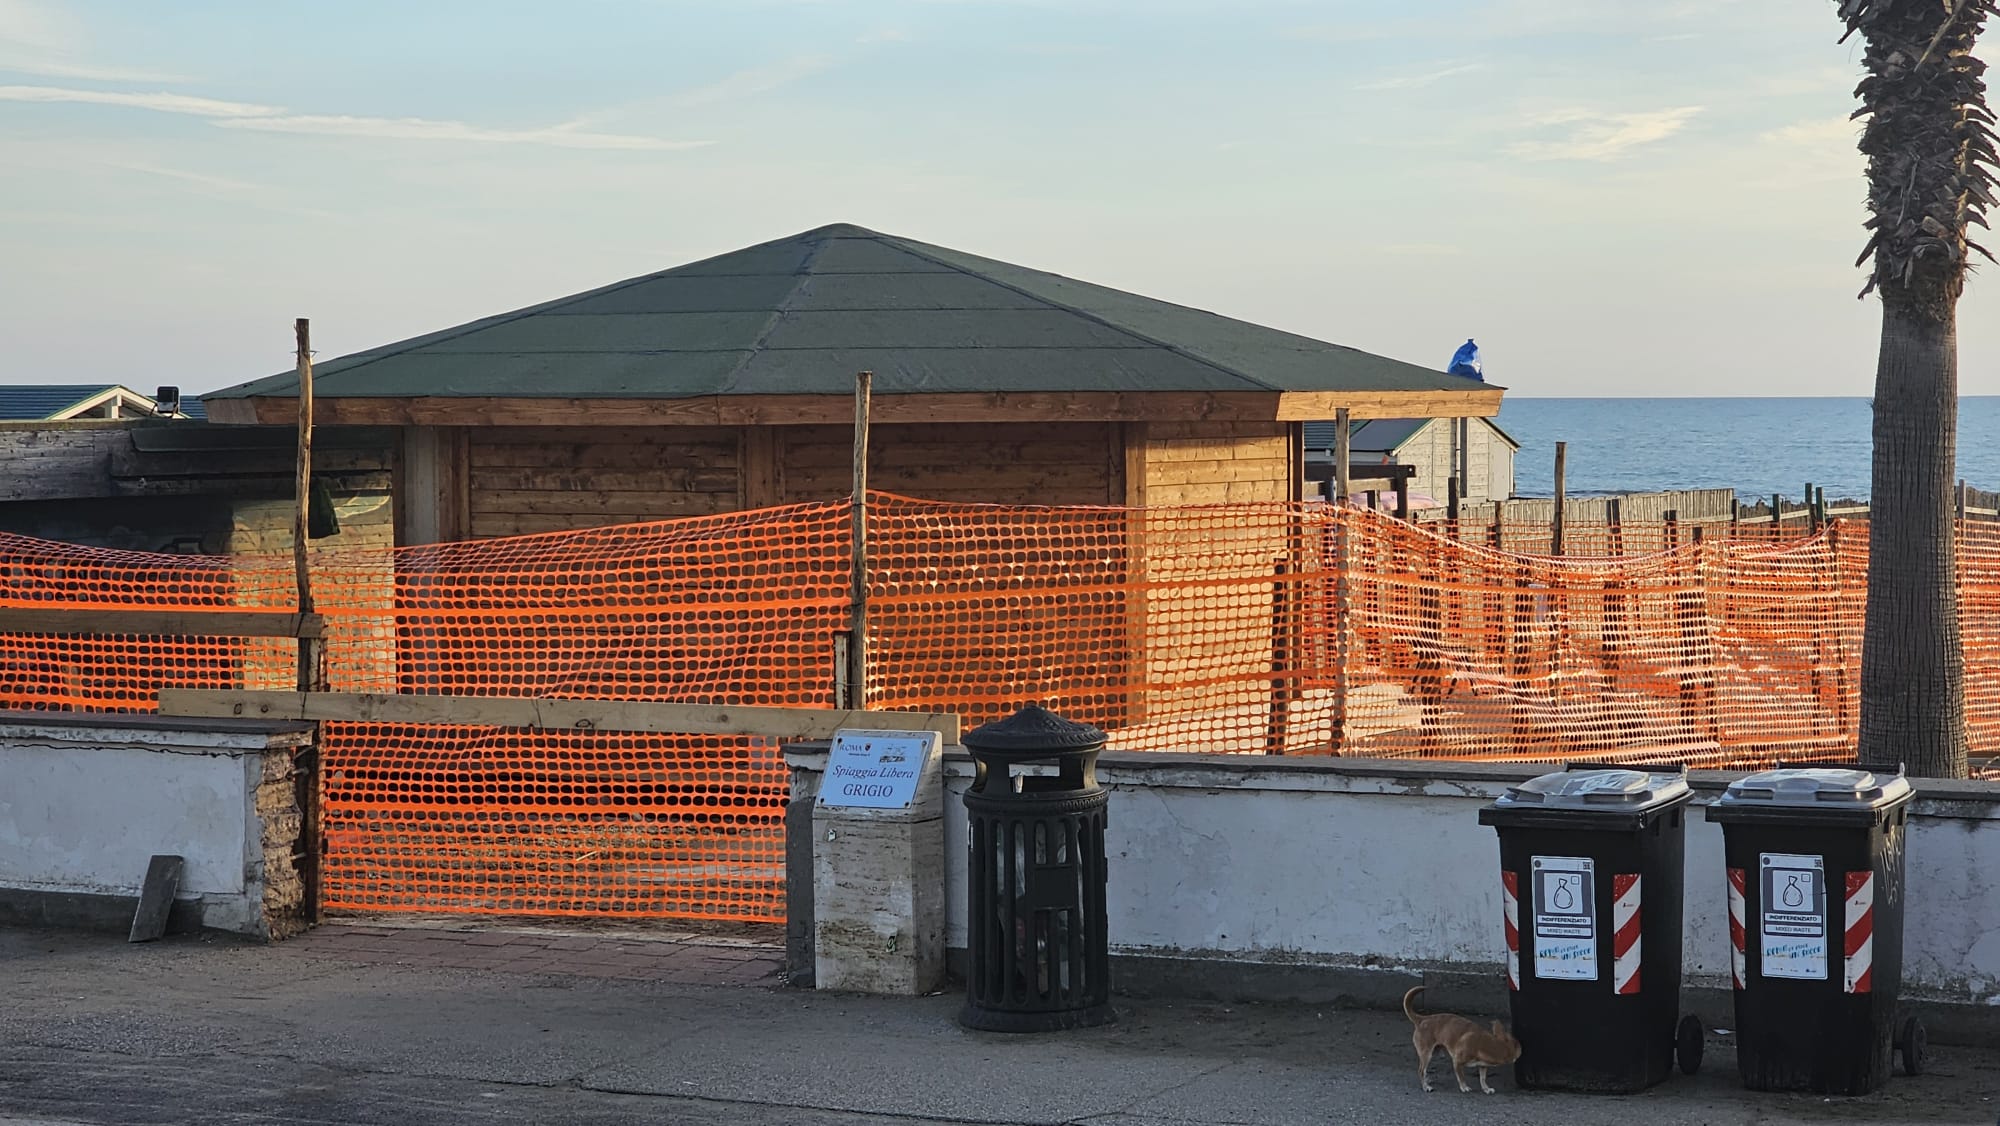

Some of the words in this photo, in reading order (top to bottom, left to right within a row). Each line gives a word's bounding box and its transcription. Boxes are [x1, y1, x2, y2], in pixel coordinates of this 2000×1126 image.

[839, 744, 863, 752] ROMA
[832, 764, 878, 780] Spiaggia
[879, 767, 914, 779] Libera
[843, 783, 894, 797] GRIGIO
